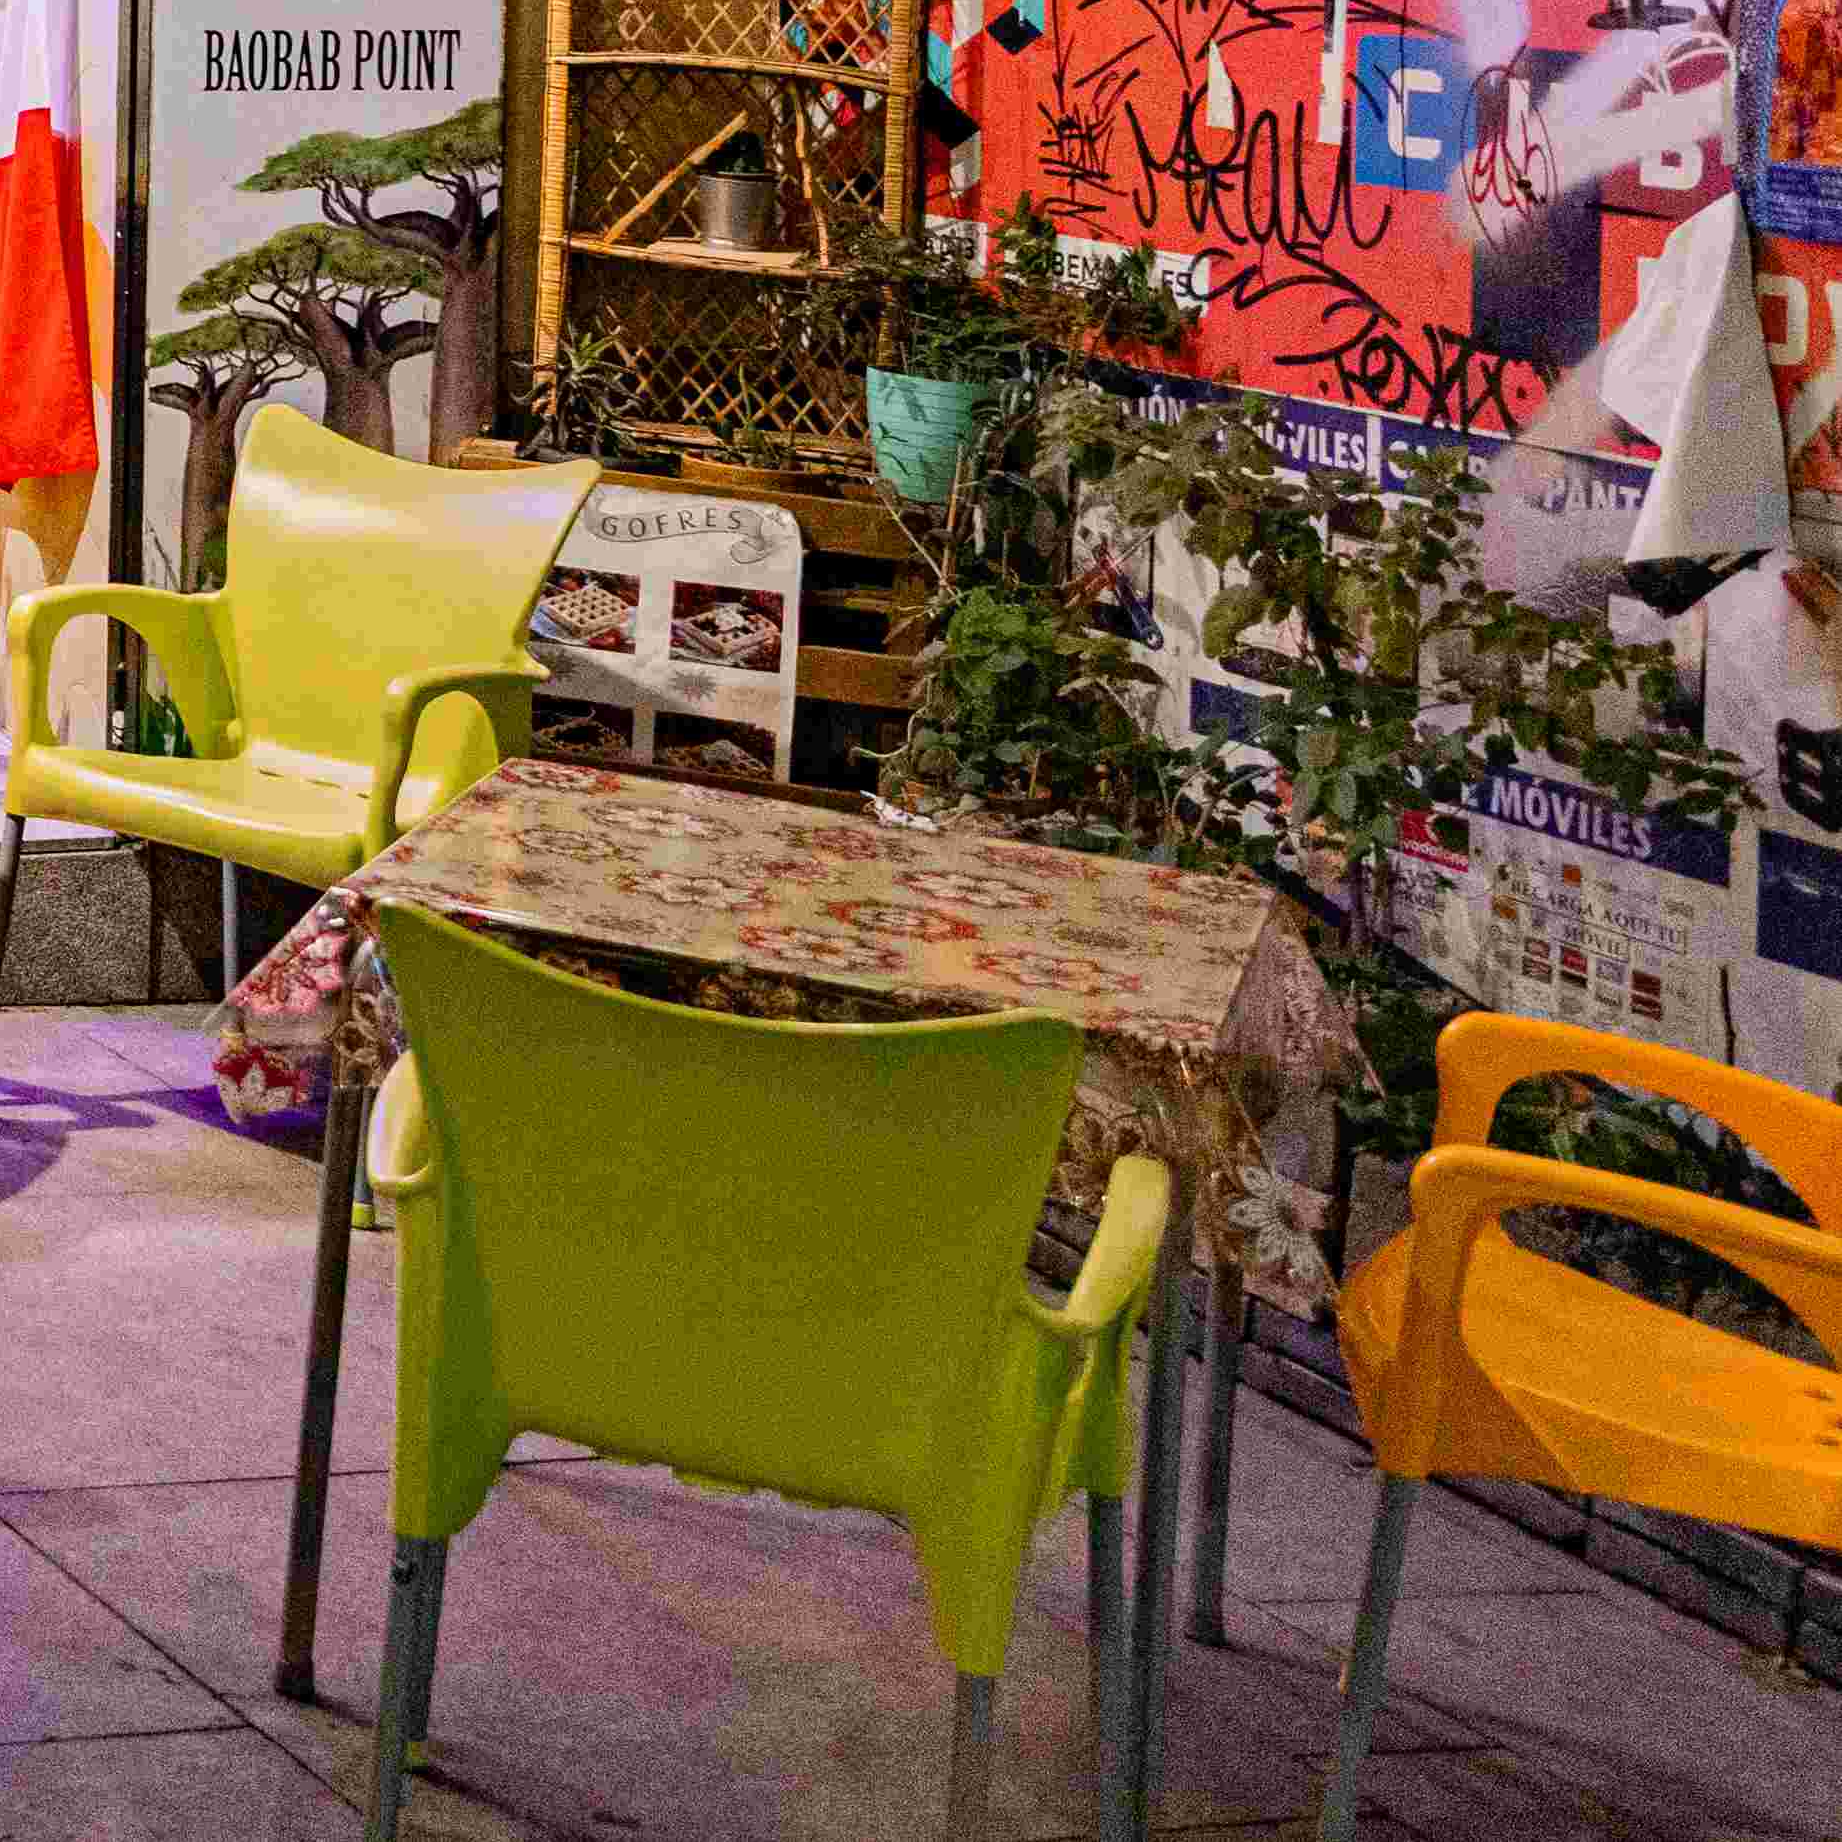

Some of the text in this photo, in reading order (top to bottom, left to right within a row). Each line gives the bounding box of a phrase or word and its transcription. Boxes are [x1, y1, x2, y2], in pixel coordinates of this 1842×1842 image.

[204, 29, 461, 92] BAOBAB POINT
[601, 506, 741, 538] GOFRES
[1491, 776, 1653, 857] MÓVILES
